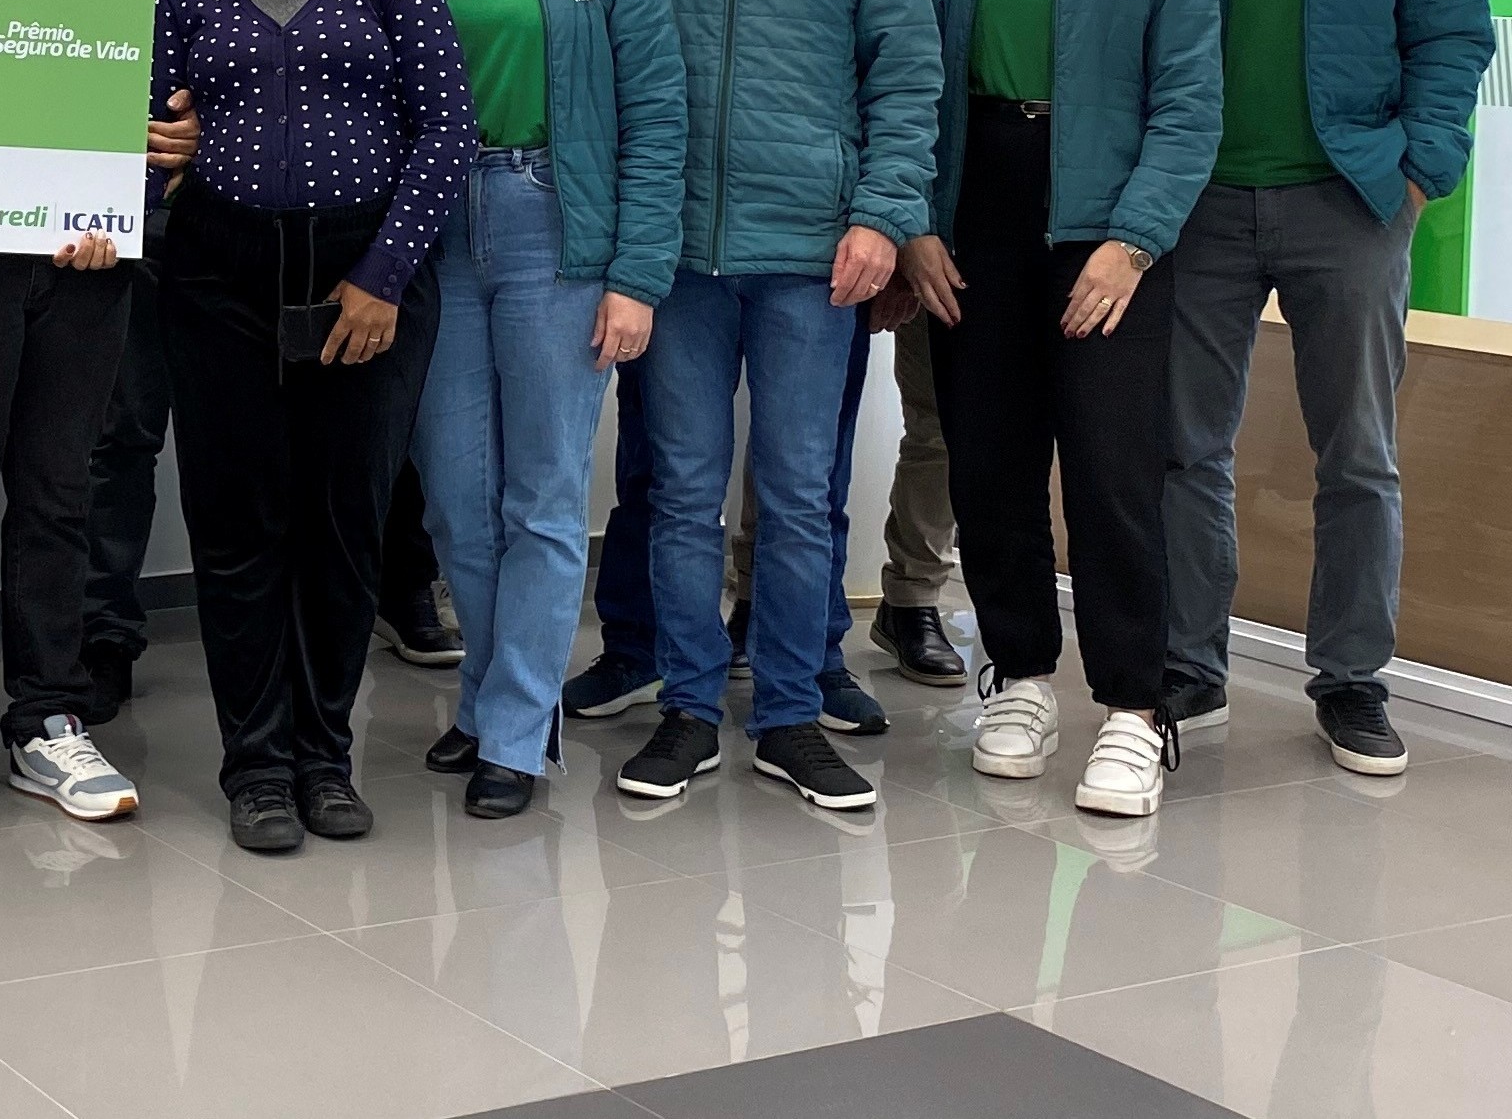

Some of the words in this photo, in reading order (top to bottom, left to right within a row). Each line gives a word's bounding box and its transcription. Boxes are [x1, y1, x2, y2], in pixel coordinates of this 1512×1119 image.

[6, 20, 75, 42] Prêmio
[66, 38, 93, 59] de
[95, 40, 141, 61] Vida
[62, 206, 135, 234] ICATU
